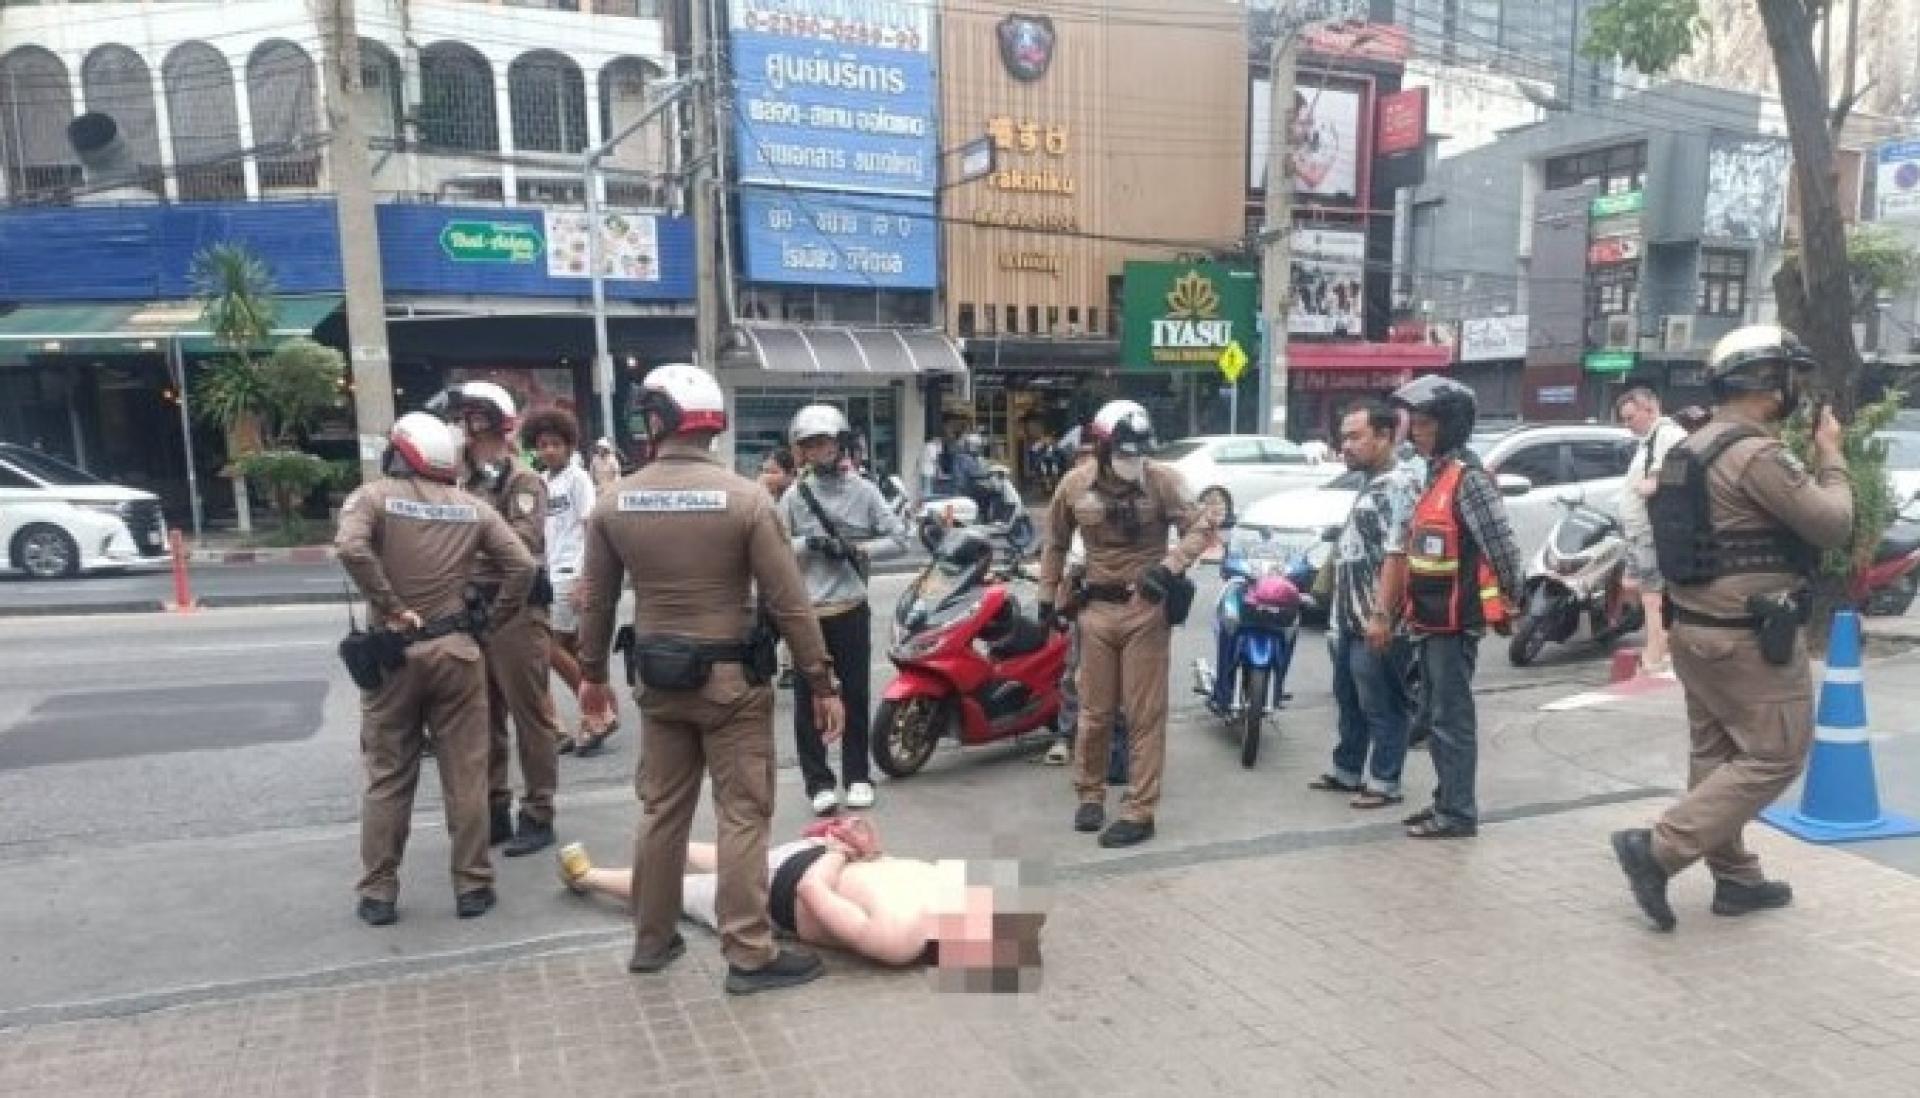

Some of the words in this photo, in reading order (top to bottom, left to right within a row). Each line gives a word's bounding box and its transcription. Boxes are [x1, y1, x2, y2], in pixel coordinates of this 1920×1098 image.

[766, 49, 906, 94] ศูนย์บริการ
[1151, 319, 1232, 347] IYASU
